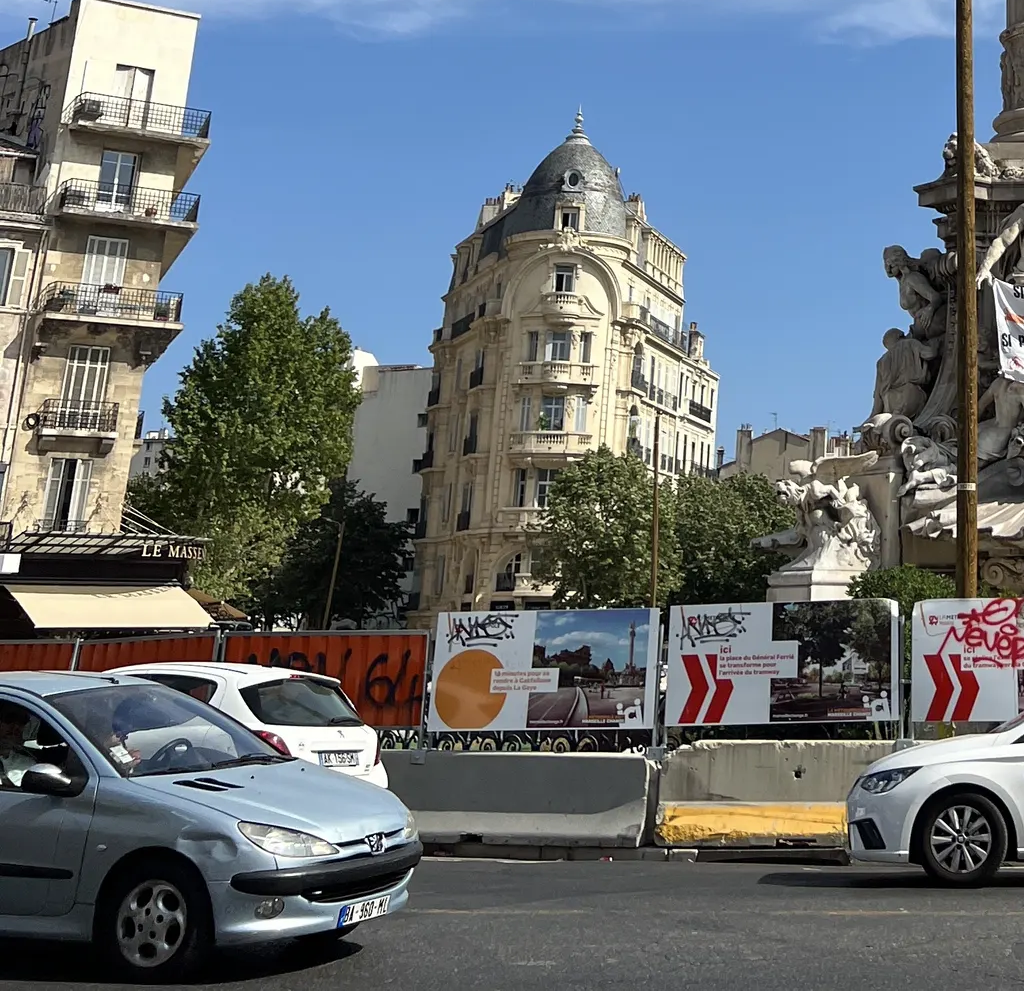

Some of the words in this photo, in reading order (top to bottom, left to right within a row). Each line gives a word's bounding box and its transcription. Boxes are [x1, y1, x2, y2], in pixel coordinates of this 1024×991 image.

[1013, 285, 1024, 299] SI
[1001, 333, 1012, 347] SI
[141, 543, 162, 557] LE
[720, 645, 732, 654] ici
[963, 646, 975, 654] ici
